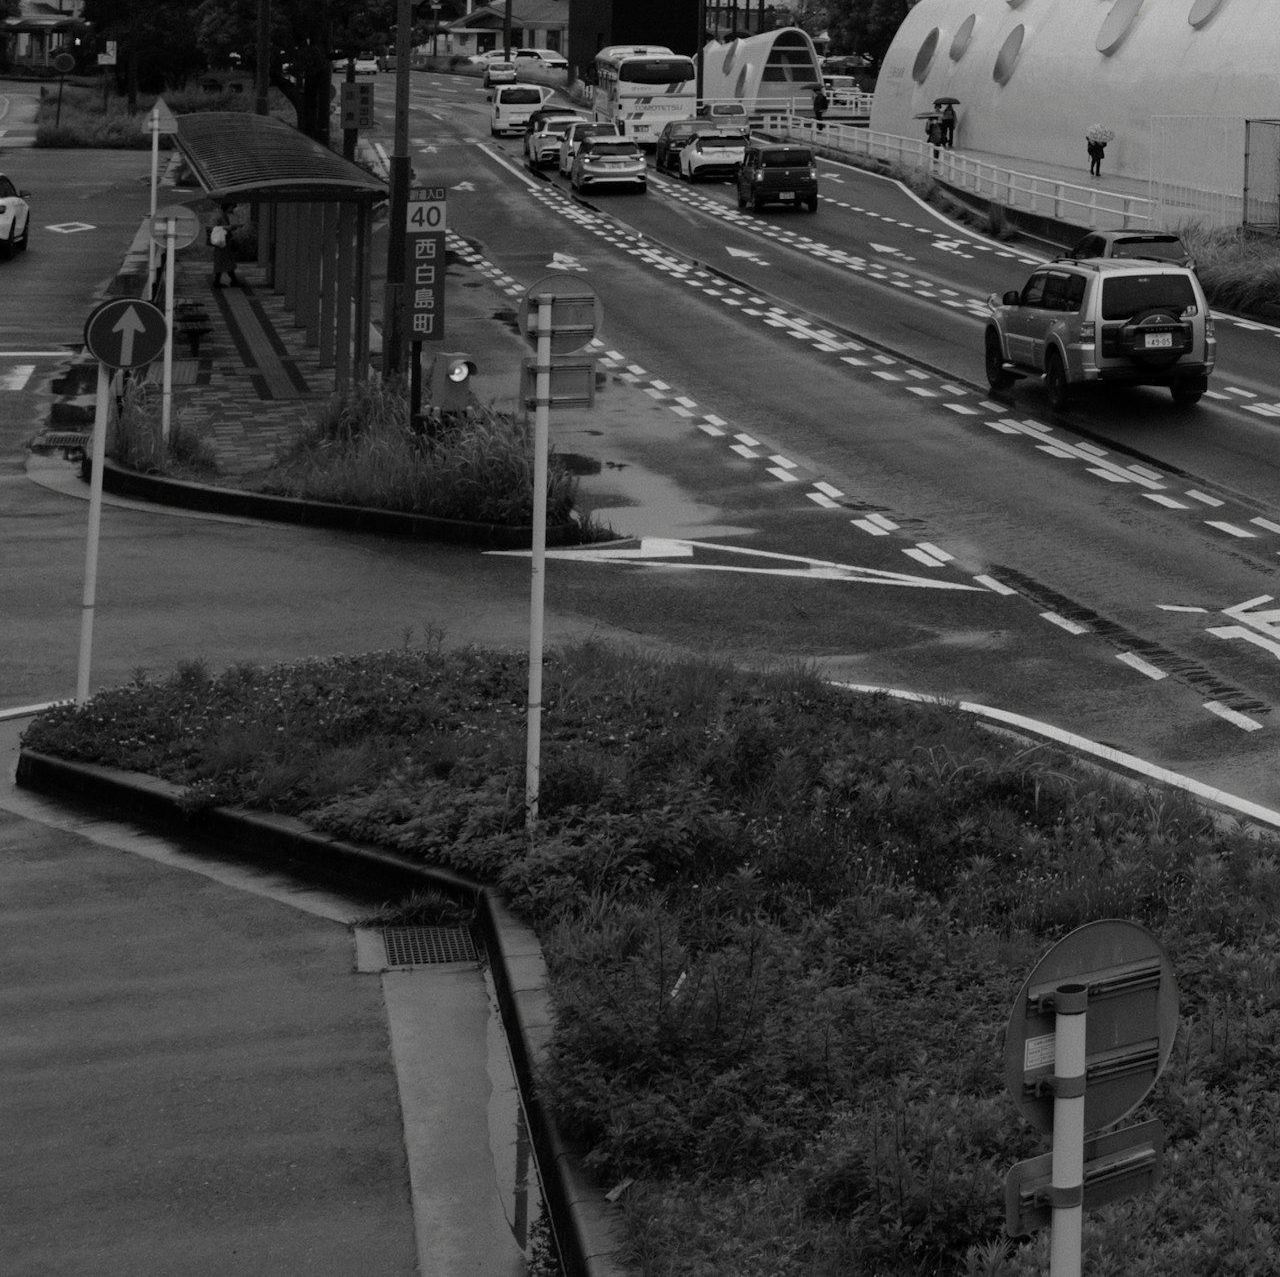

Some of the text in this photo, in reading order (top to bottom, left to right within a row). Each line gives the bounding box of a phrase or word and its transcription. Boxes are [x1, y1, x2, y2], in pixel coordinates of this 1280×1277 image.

[411, 206, 441, 227] 40
[413, 238, 437, 334] 西白島町
